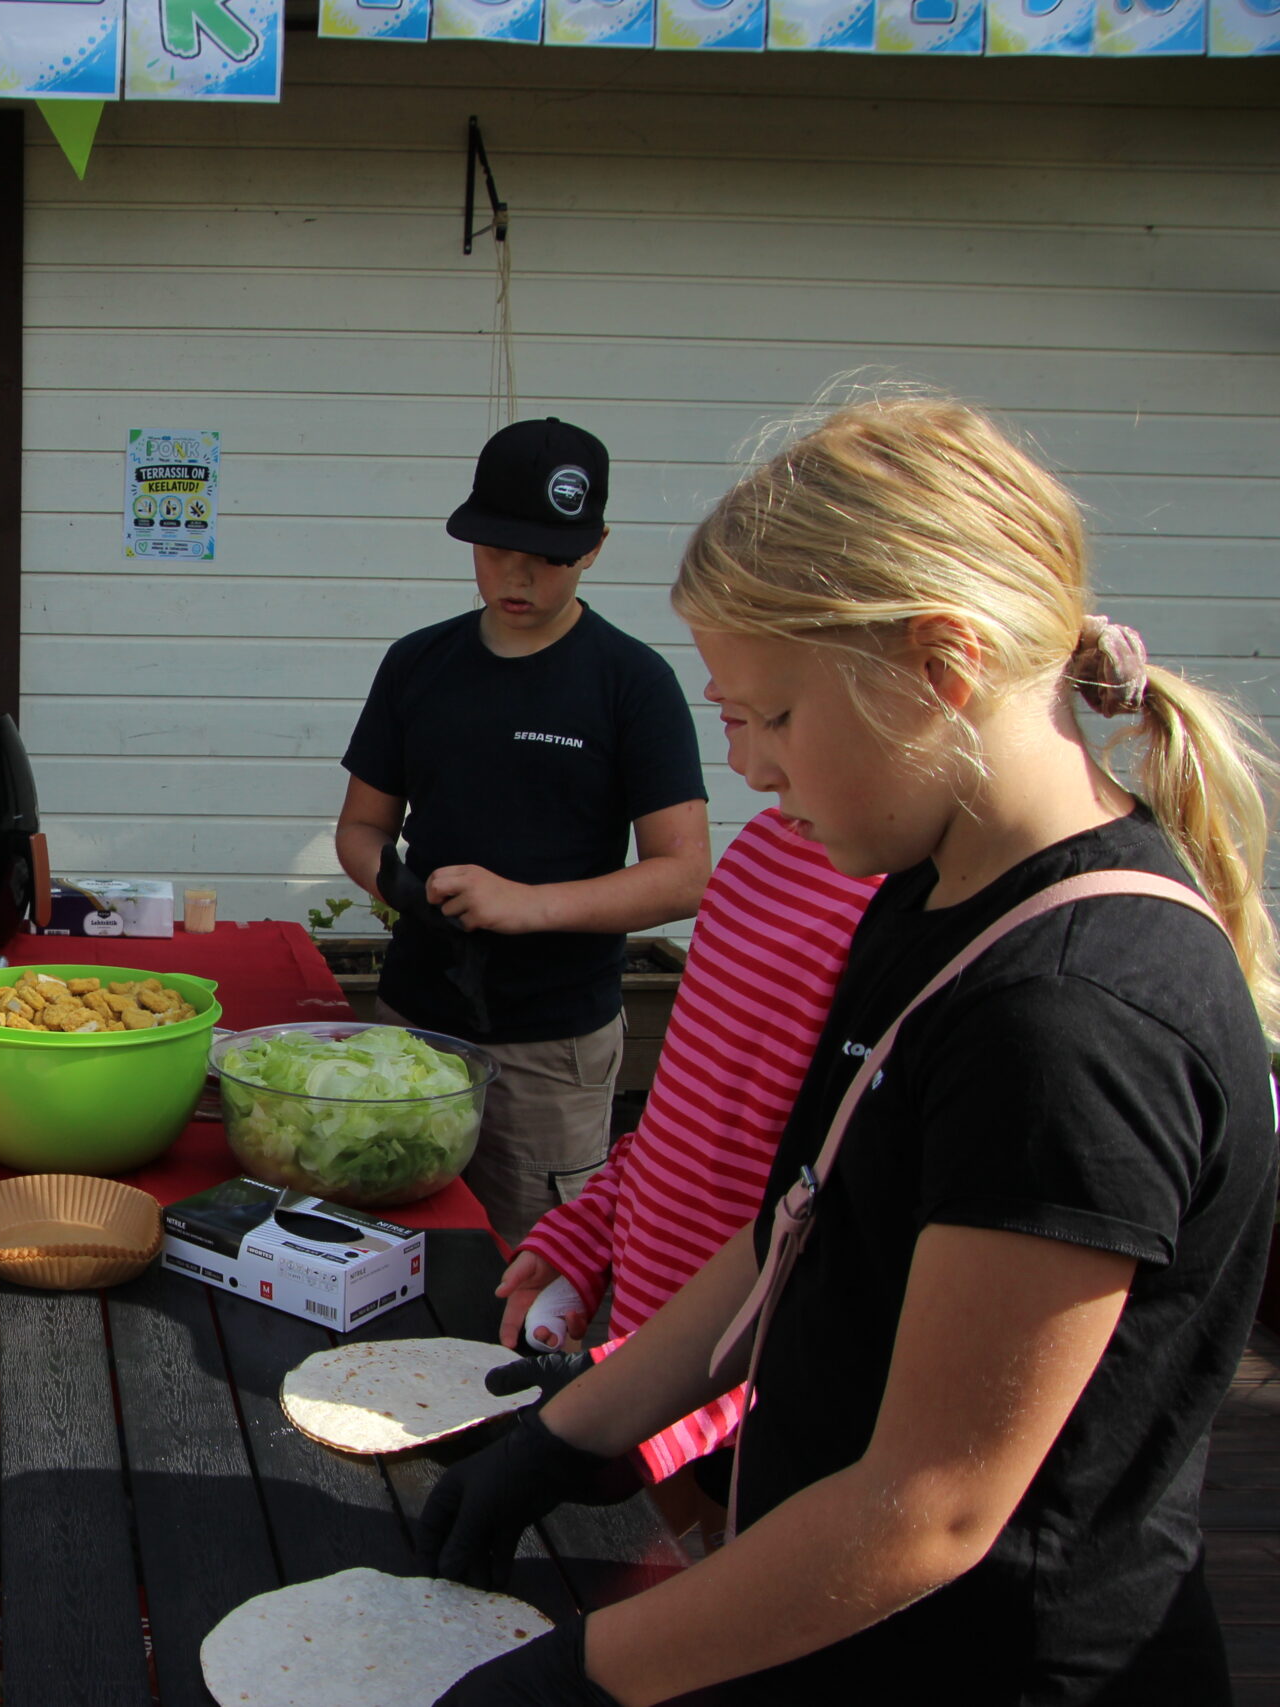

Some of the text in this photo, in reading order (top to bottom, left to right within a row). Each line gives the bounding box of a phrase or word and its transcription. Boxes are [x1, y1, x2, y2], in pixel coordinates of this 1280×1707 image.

[140, 466, 205, 480] TERRASSIL ON
[148, 482, 200, 493] KEELATUD!
[513, 731, 583, 748] SEBASTIAN
[376, 1220, 414, 1235] NITRILE
[262, 1285, 270, 1294] M
